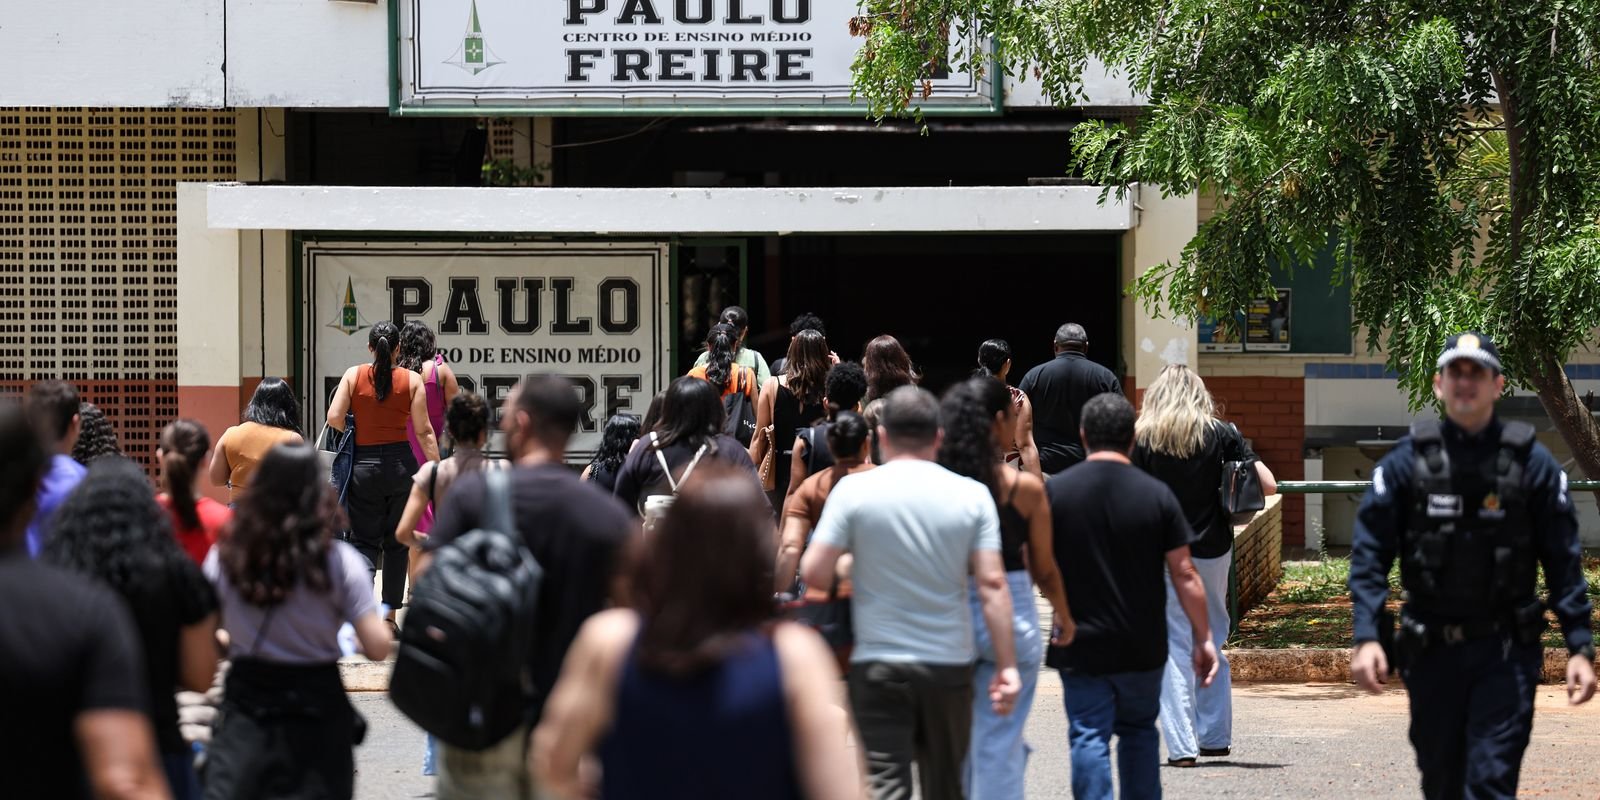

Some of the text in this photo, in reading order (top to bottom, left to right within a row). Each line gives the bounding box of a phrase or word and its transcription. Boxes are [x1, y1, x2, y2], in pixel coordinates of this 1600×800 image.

[563, 0, 812, 26] PAULO
[563, 31, 812, 43] CENTRO DE ENSINO MÉDIO
[564, 48, 813, 82] FREIRE
[385, 276, 641, 335] PAULO
[469, 347, 495, 364] DE
[501, 347, 572, 364] ENSINO
[577, 345, 641, 364] MÉDIO
